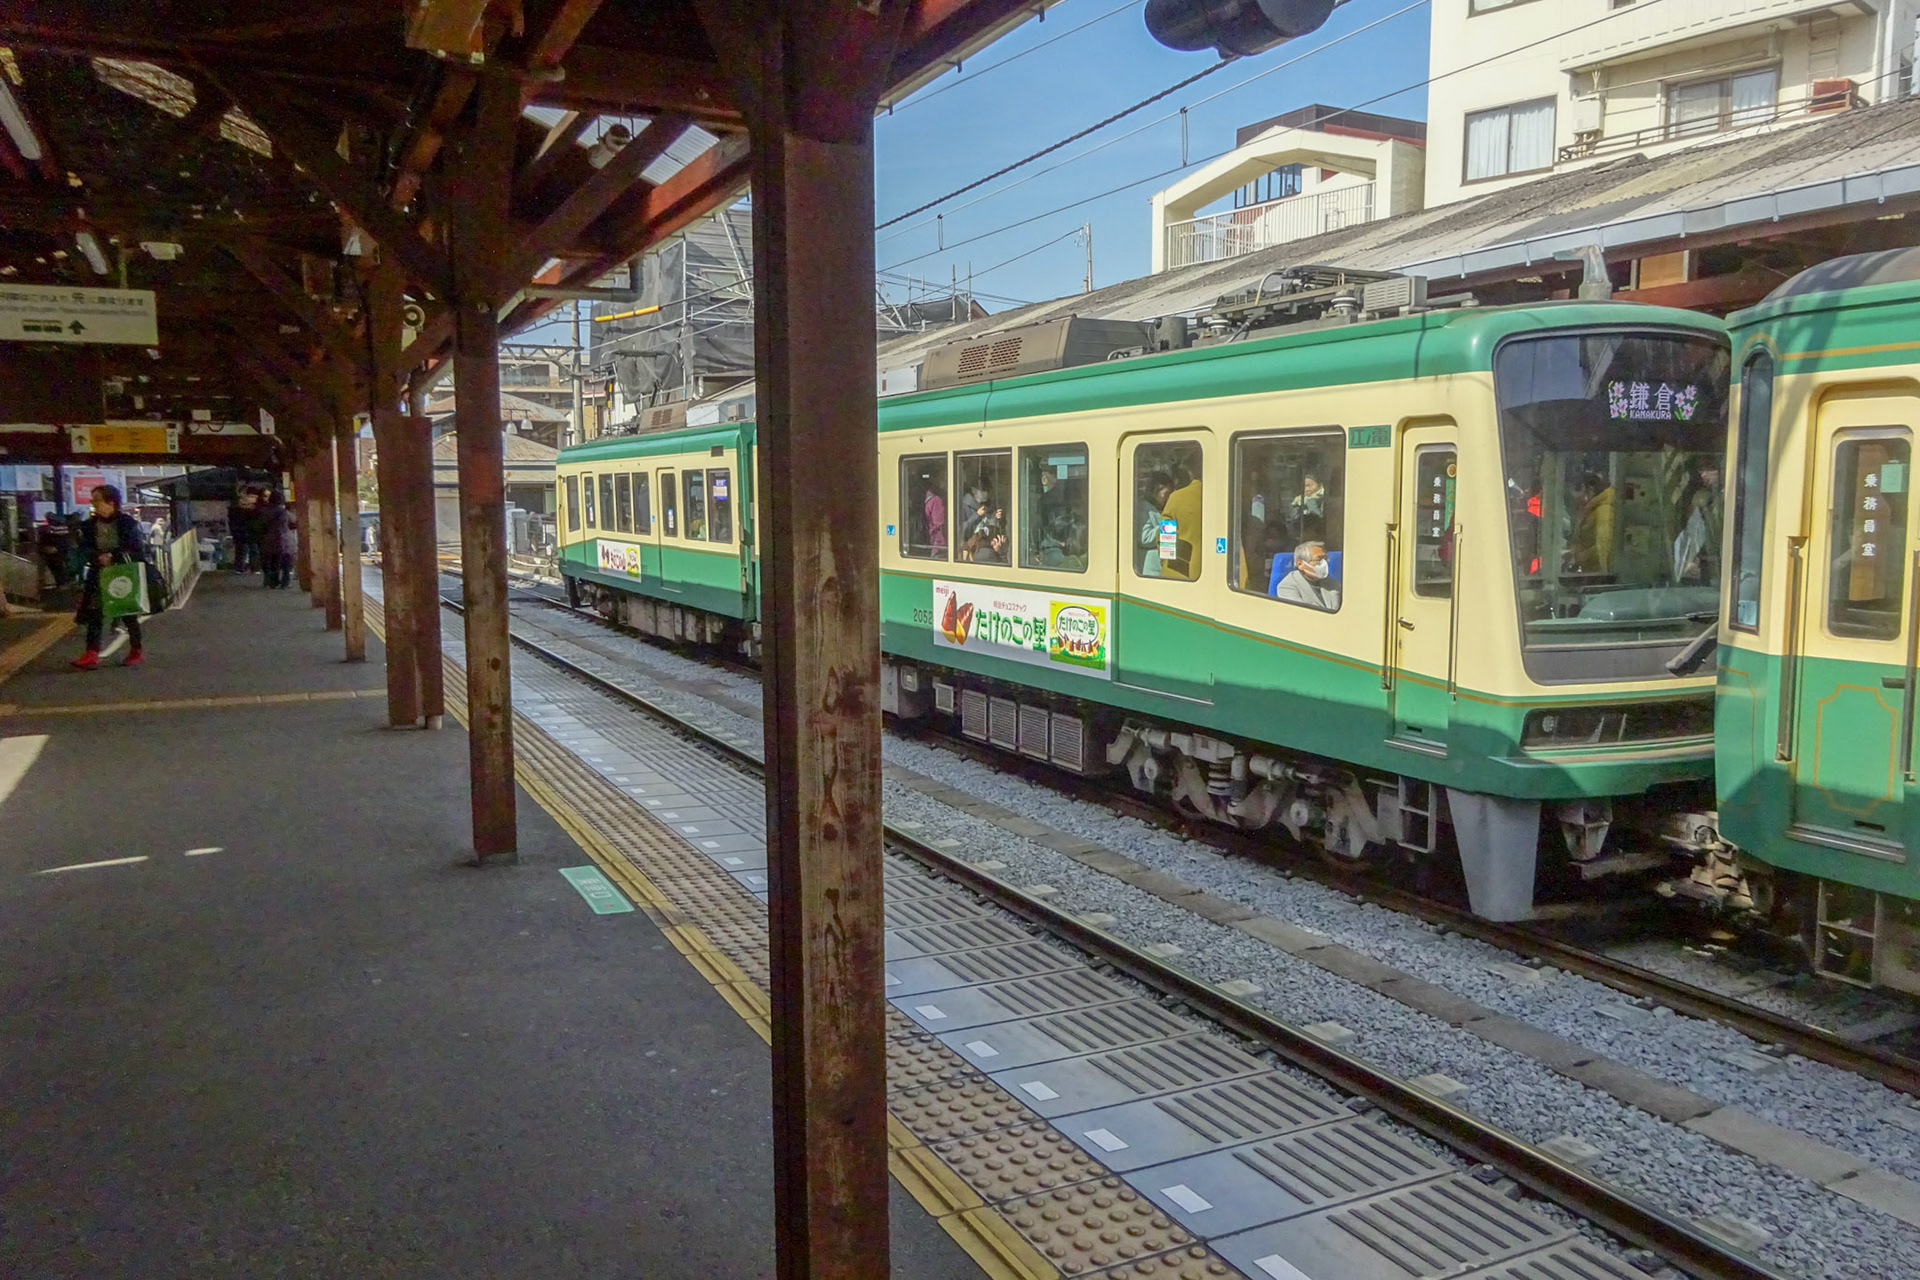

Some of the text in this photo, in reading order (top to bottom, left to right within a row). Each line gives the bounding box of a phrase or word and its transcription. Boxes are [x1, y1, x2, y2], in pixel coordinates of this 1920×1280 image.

[1629, 382, 1674, 411] 鎌倉
[1630, 409, 1672, 420] KAMAKURA
[1350, 427, 1388, 446] 江ノ電
[1432, 476, 1441, 537] 乗務員室
[1862, 473, 1878, 556] 乗務員室
[935, 585, 950, 597] meiji
[913, 608, 933, 625] 2052
[1058, 615, 1096, 636] たけのこの里
[975, 608, 1047, 652] たけのこの里
